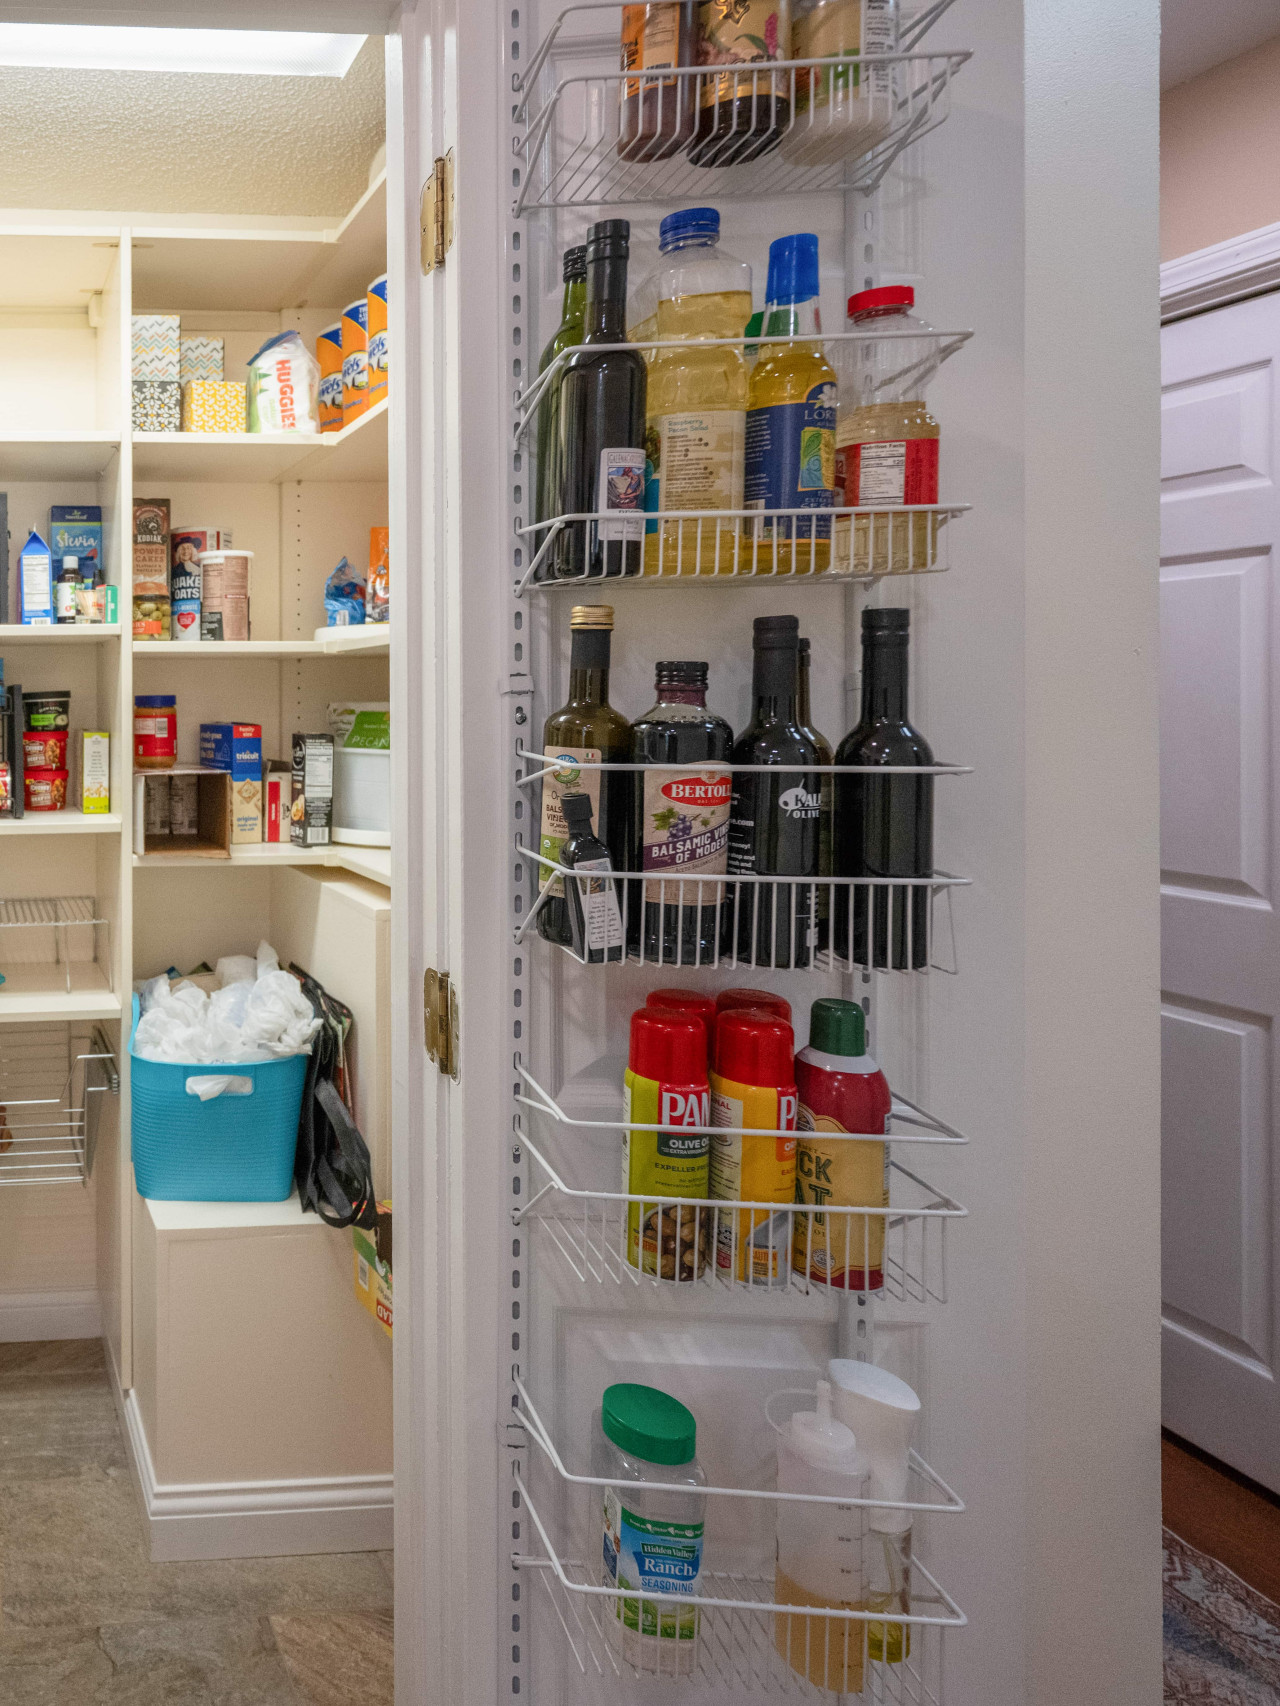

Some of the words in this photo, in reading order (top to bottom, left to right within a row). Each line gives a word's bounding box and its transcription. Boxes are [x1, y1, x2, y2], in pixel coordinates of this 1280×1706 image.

[276, 359, 297, 430] HUGGIES
[56, 533, 98, 547] Stevia
[137, 534, 162, 543] KODIAK
[174, 588, 200, 599] OATS
[236, 752, 259, 760] triscuit
[651, 833, 712, 858] BALSAMIC
[675, 851, 691, 864] OF
[669, 1139, 700, 1149] OLIVE
[654, 1162, 696, 1173] EXPELLER
[643, 1544, 671, 1556] Hidden
[672, 1548, 694, 1560] Valley
[643, 1557, 693, 1577] Ranch
[642, 1576, 694, 1593] SEASONING
